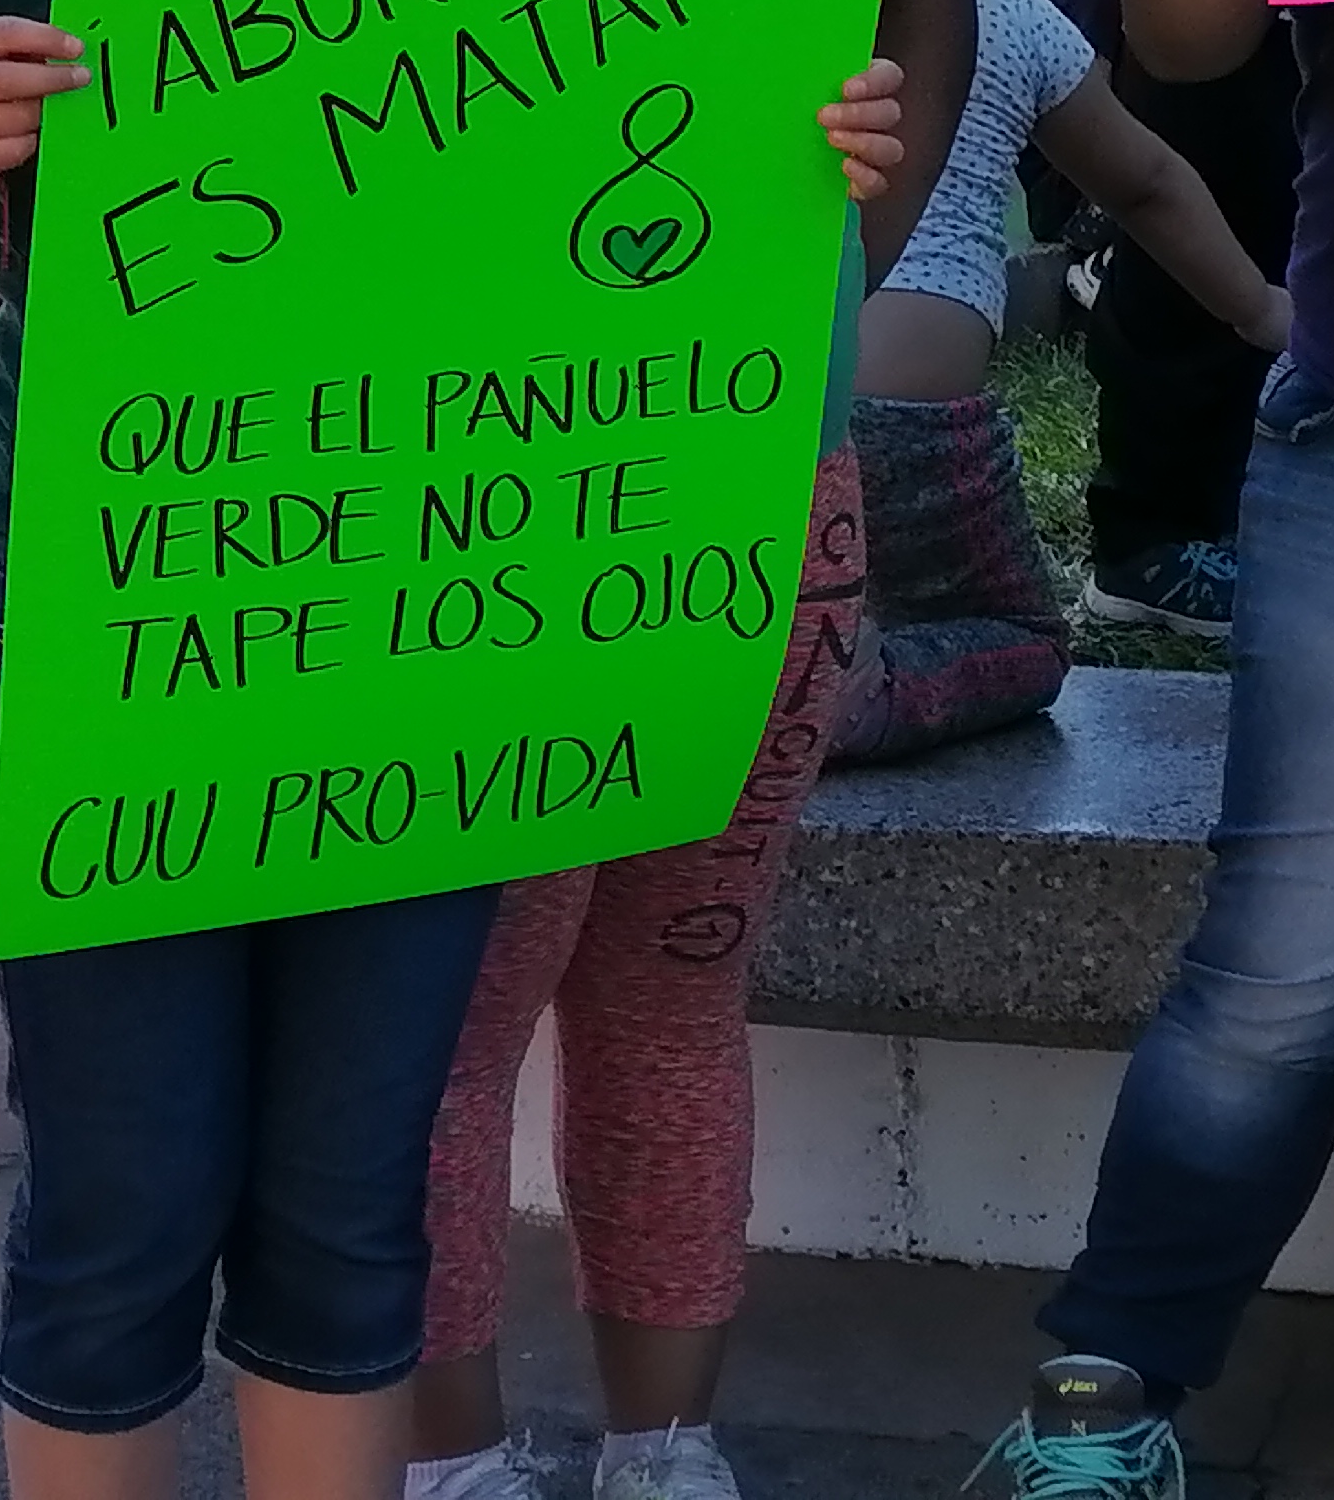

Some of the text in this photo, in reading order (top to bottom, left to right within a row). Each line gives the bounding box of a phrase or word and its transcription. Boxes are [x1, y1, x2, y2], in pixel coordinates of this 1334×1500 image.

[102, 157, 283, 317] ES
[99, 338, 784, 478] QUE EL PAÑUELO
[99, 455, 672, 591] VERDE NO TE
[105, 536, 779, 701] TAPE LOS OJOS
[38, 721, 645, 901] CUU PRO-VIDA
